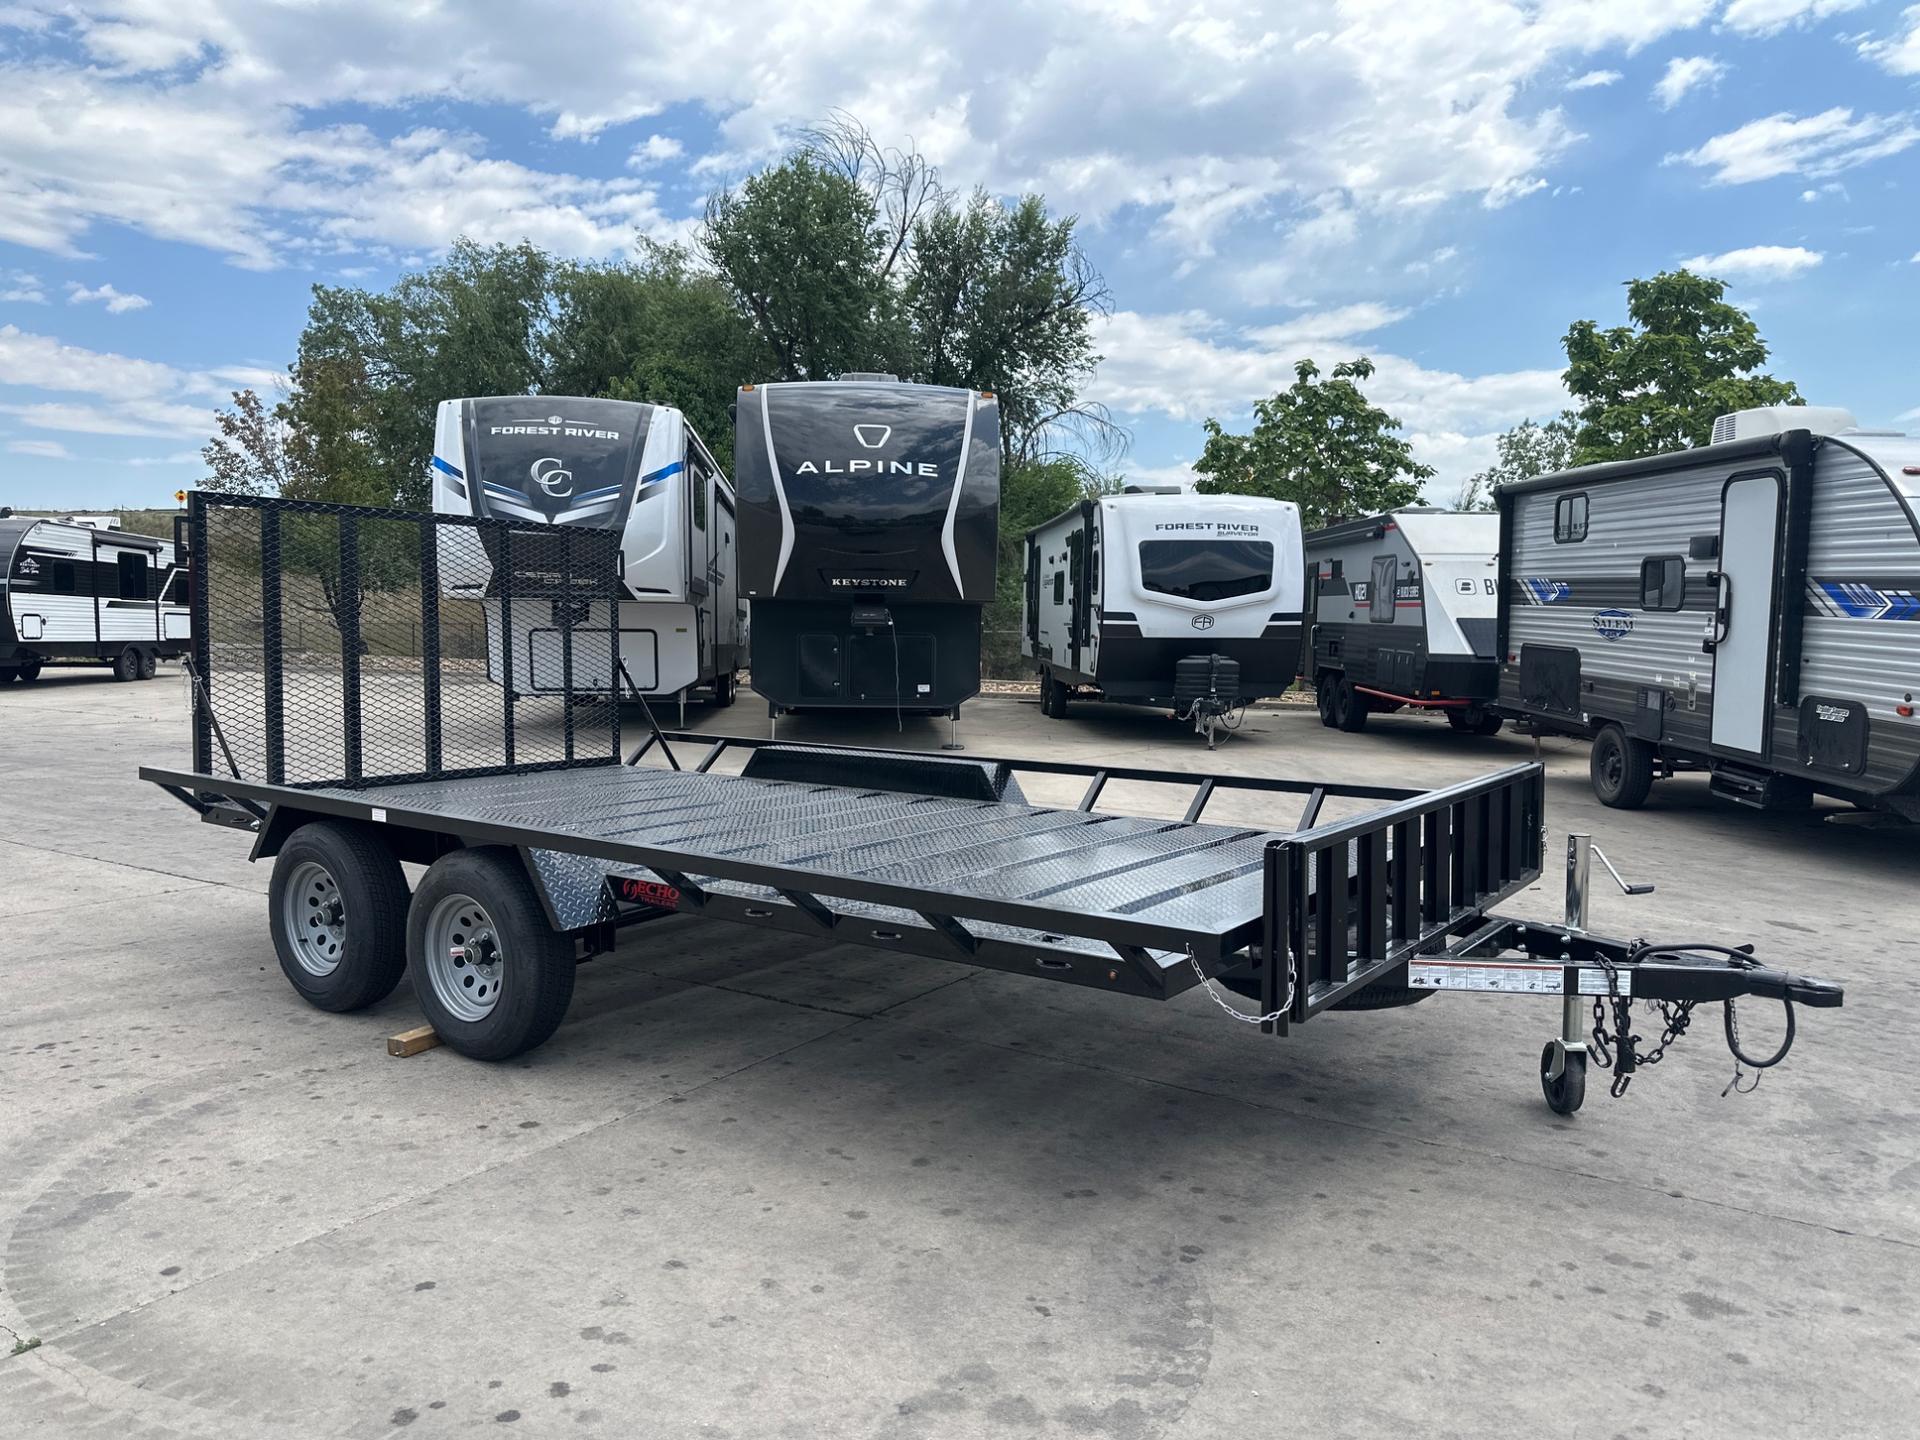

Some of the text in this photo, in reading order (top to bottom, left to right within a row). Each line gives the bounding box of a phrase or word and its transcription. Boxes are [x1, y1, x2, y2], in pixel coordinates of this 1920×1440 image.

[491, 426, 620, 440] FOREST RIVER
[795, 460, 939, 478] ALPINE
[1155, 522, 1259, 532] FOREST RIVER
[832, 578, 908, 587] KEYSTONE
[1592, 617, 1634, 629] SALEM
[638, 881, 680, 899] ECHO
